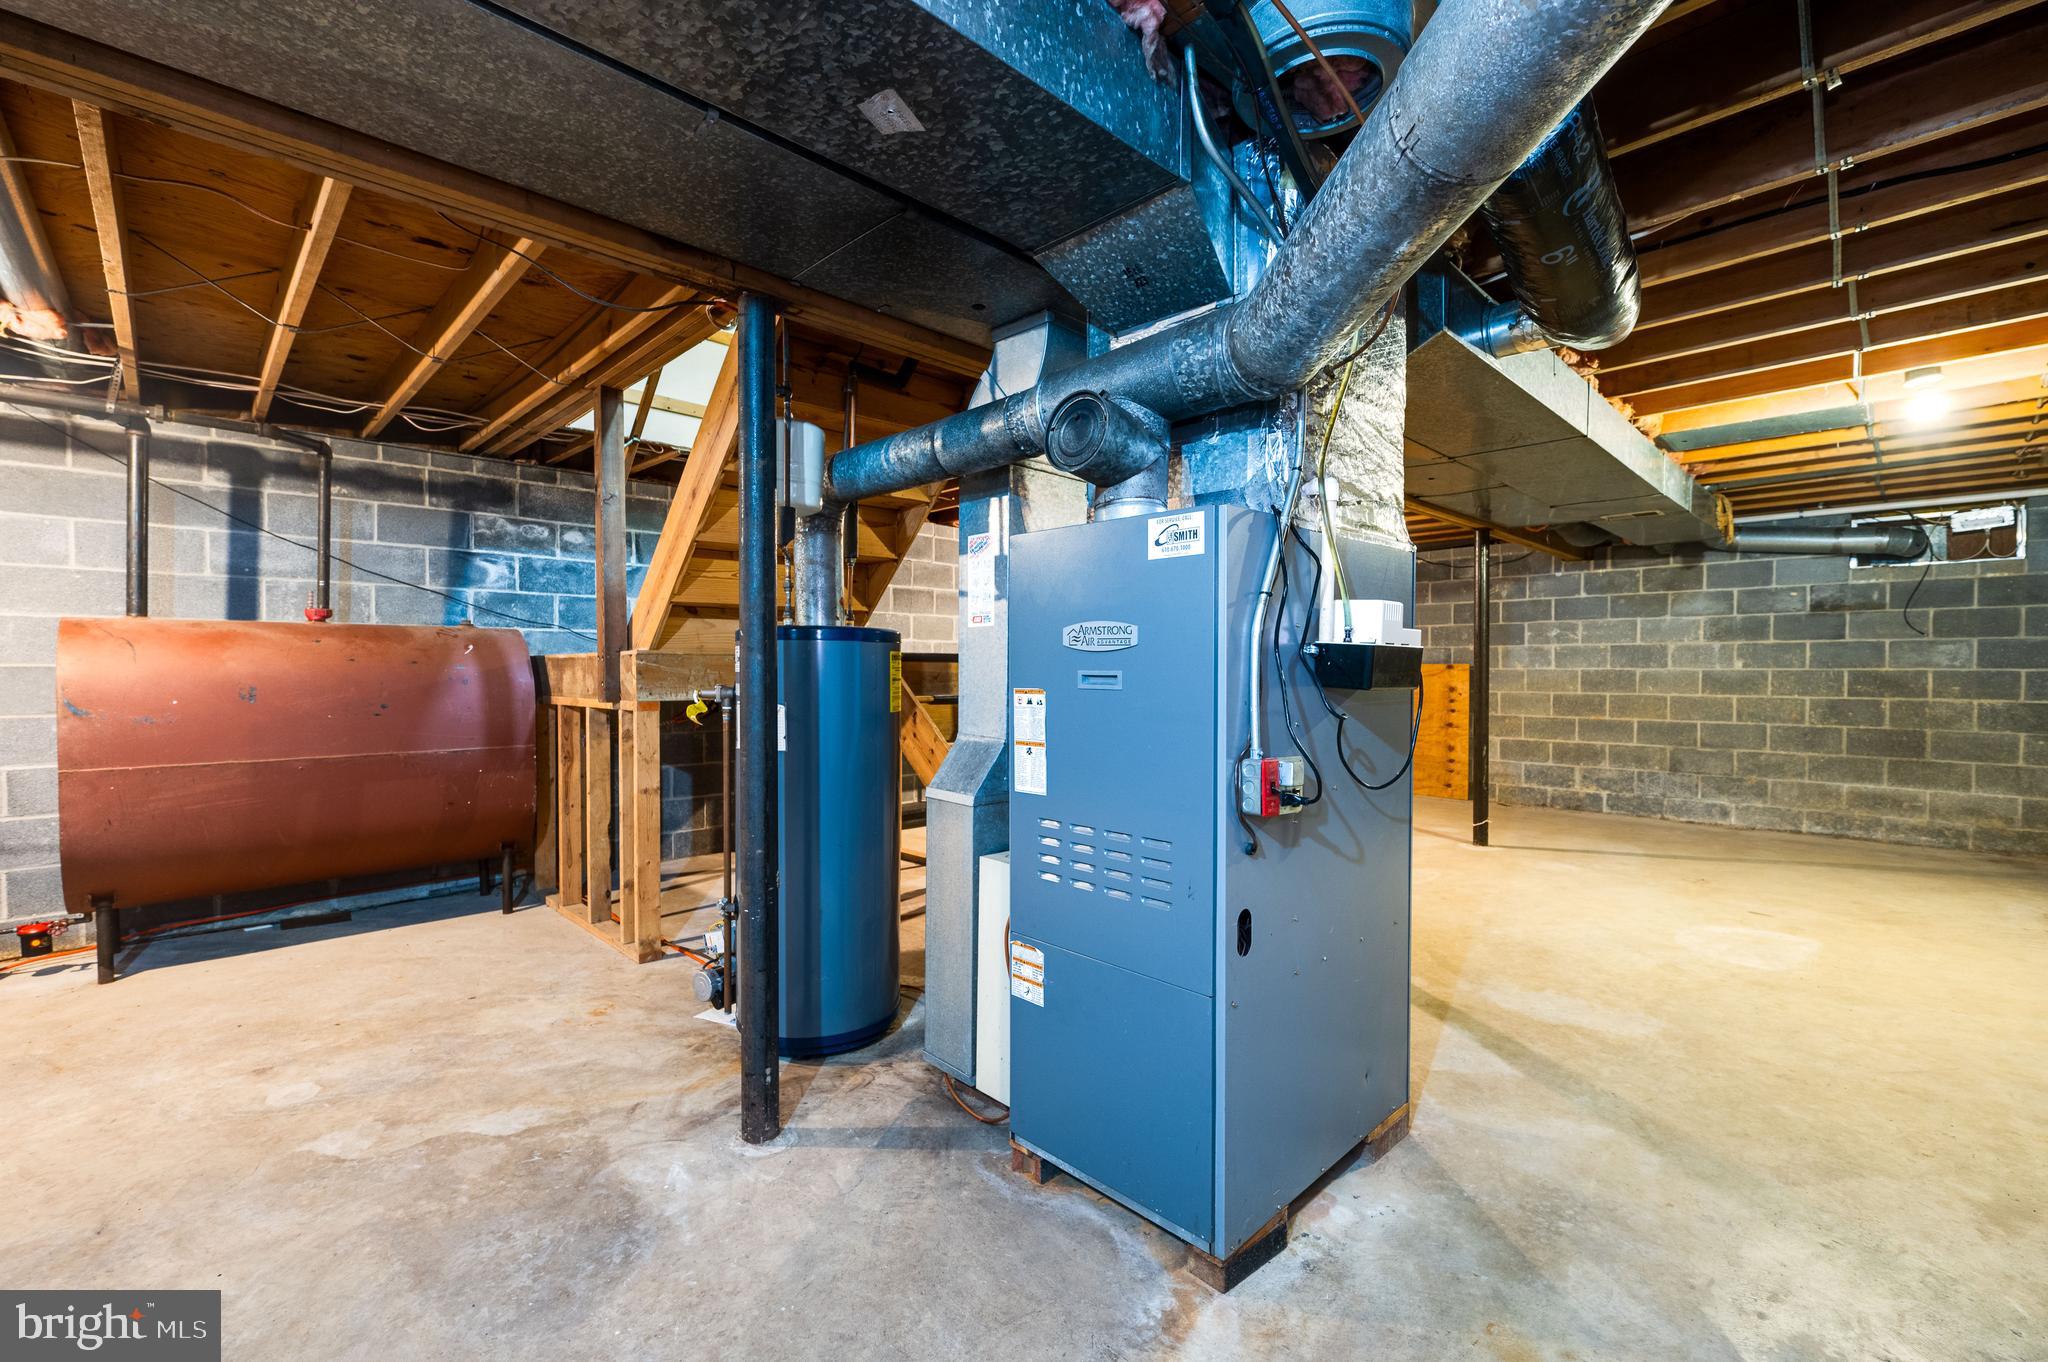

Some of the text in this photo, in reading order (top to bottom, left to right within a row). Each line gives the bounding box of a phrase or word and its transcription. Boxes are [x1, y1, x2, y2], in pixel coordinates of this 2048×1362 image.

[1173, 528, 1198, 542] SMITH
[1077, 624, 1133, 636] ARMSTRONG
[1080, 635, 1096, 647] AIR
